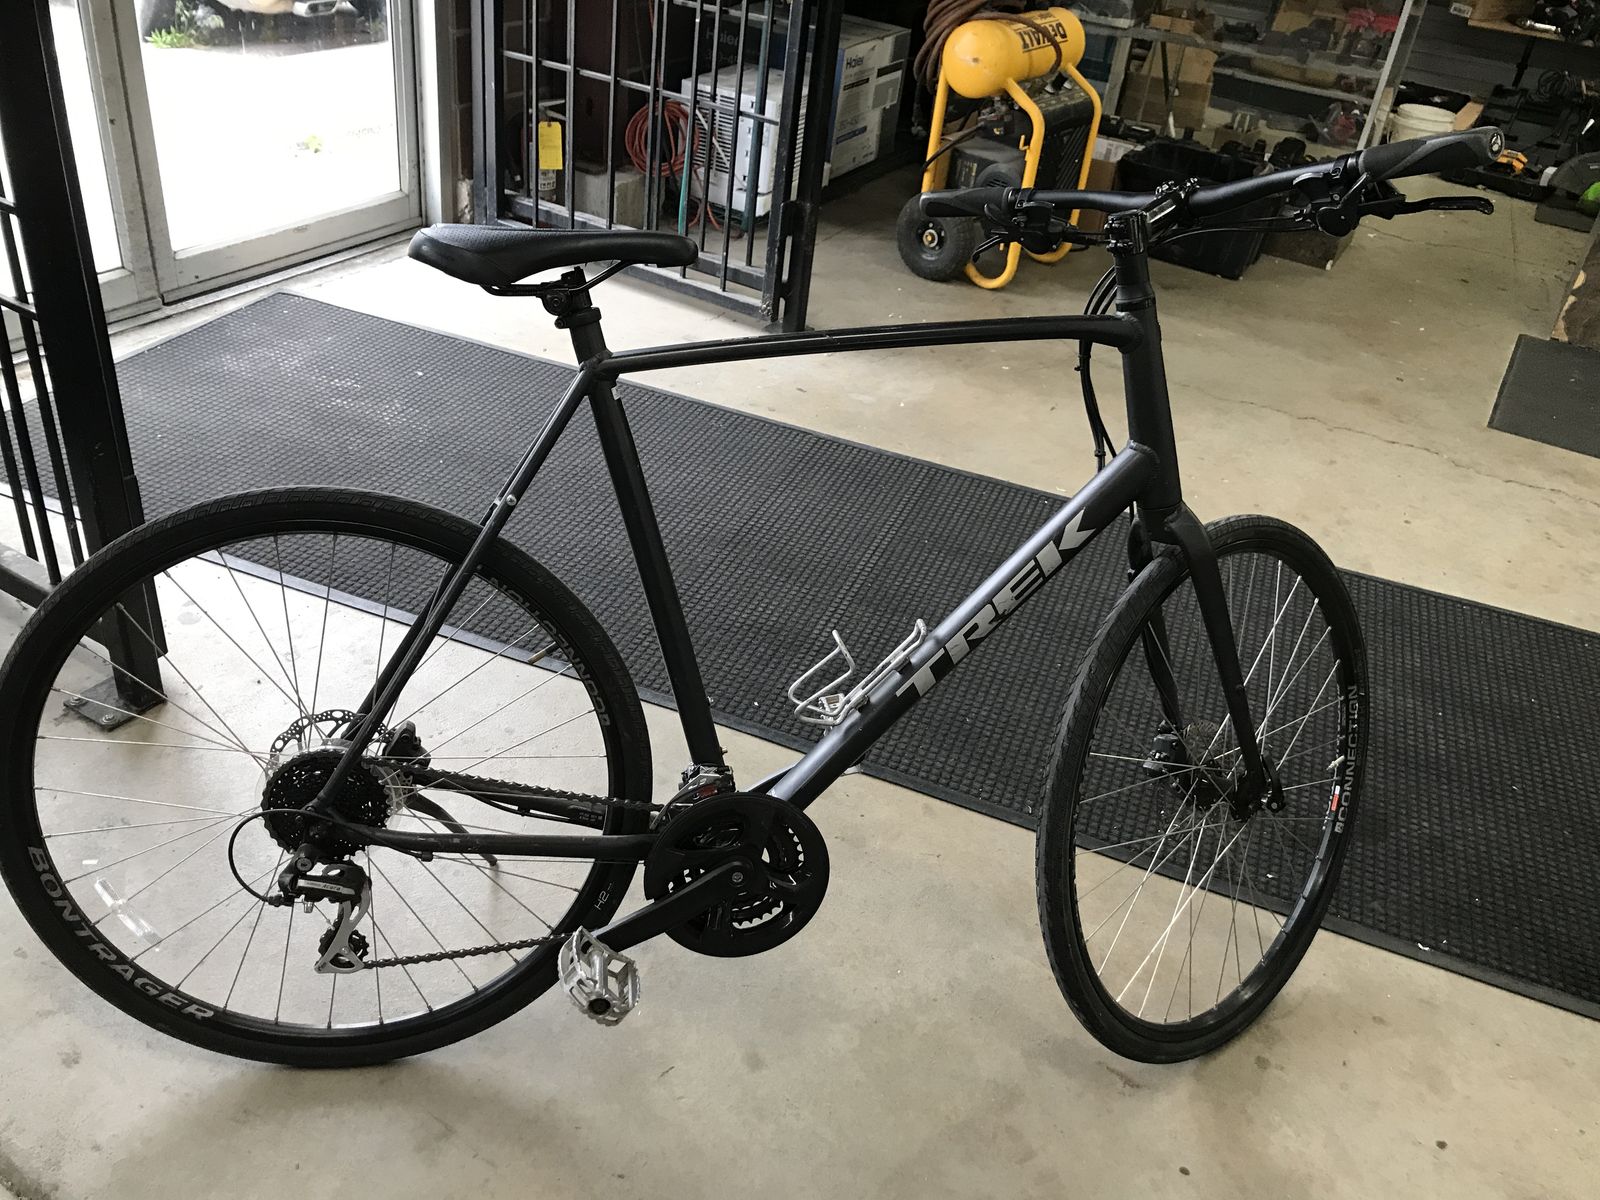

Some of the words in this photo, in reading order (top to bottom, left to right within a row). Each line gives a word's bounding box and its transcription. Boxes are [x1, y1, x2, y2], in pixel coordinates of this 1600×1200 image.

[845, 55, 864, 70] Haier
[895, 506, 1097, 697] TREK
[1338, 685, 1359, 822] CONNECTION
[28, 846, 215, 1020] BONTRAGER
